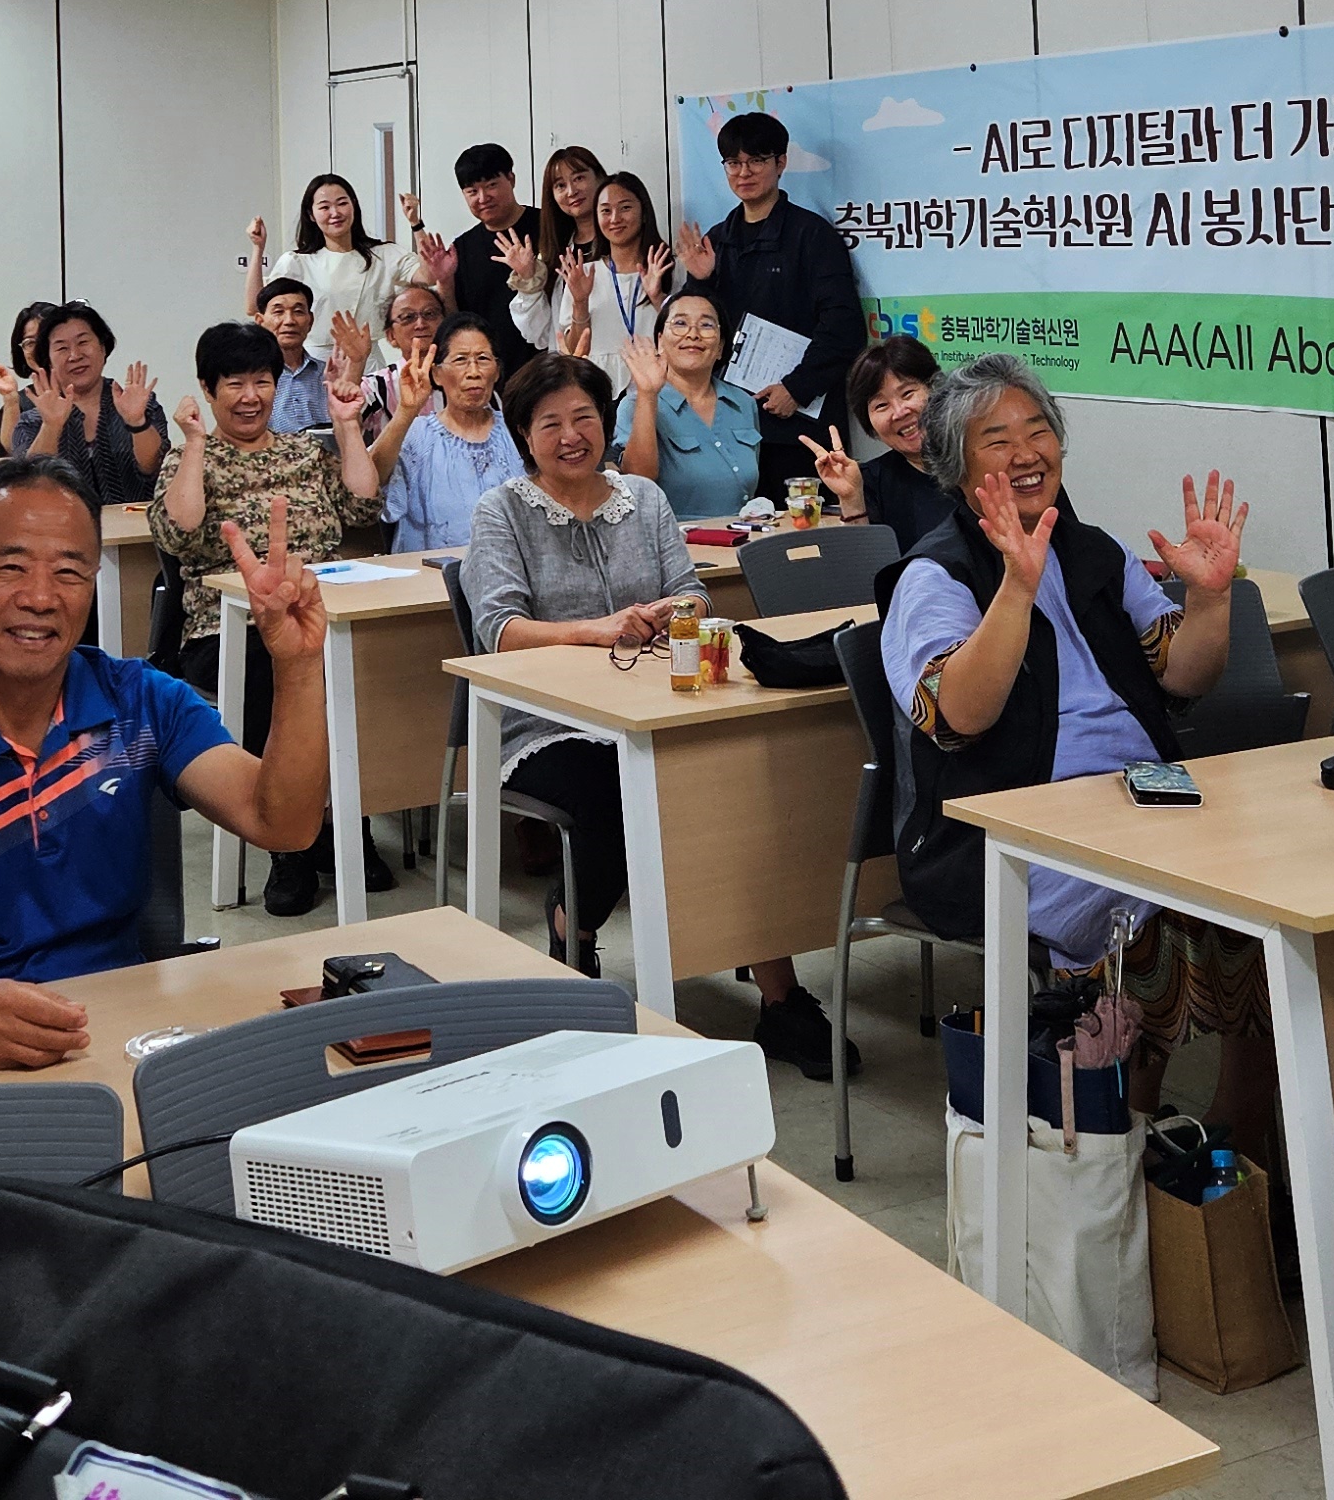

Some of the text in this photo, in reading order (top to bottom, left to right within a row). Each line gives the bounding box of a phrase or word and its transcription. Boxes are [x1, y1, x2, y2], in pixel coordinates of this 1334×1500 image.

[980, 119, 1056, 174] AI로
[1062, 106, 1223, 171] 디지털과
[1230, 101, 1273, 162] 더
[834, 192, 1134, 250] 충북과학기술혁신원
[1145, 191, 1191, 247] AI
[940, 314, 1080, 347] 충북과학기술혁신원
[1109, 321, 1254, 371] AAA(All
[1030, 353, 1080, 372] Technology
